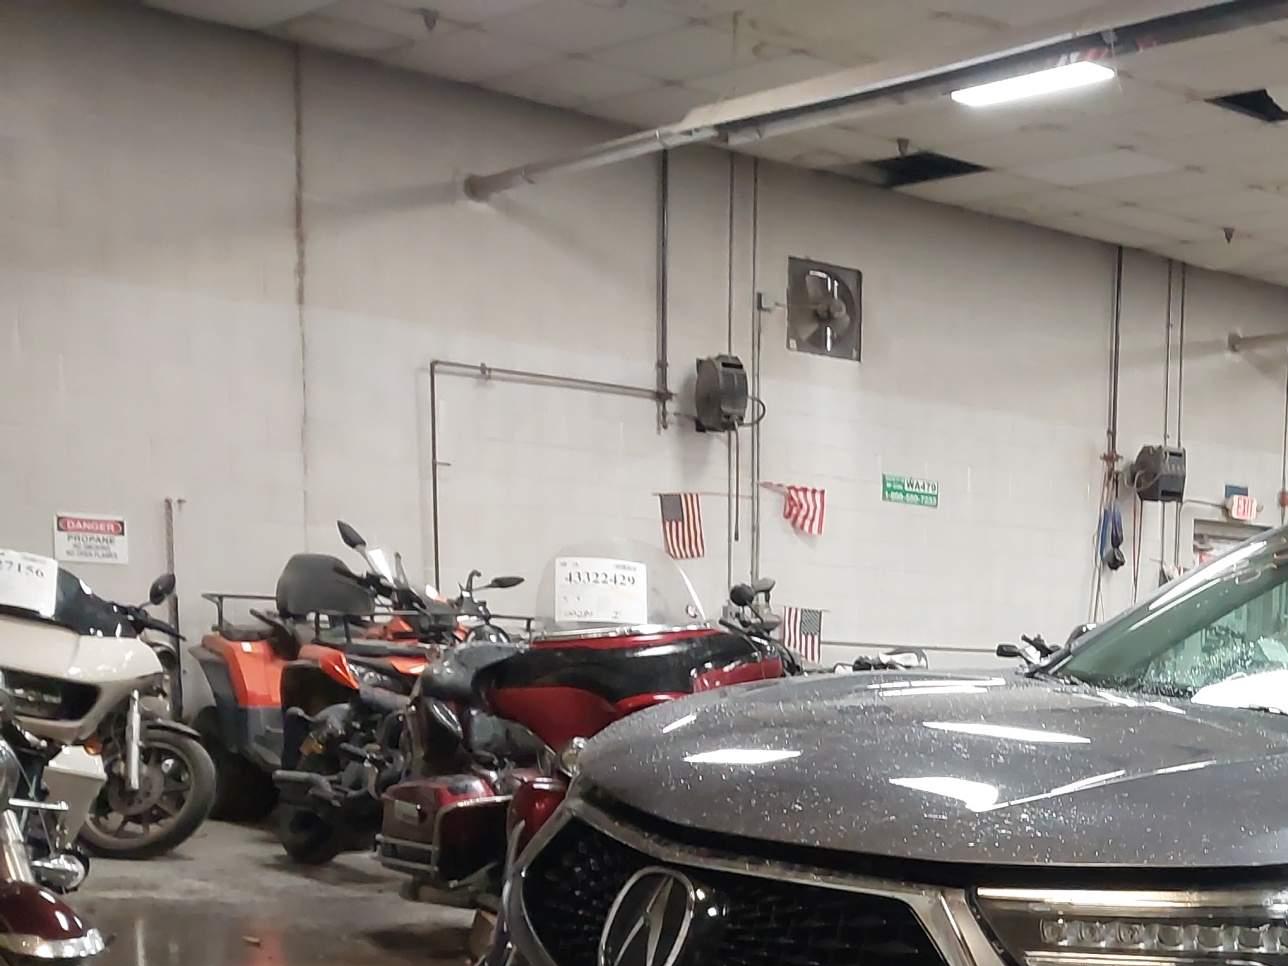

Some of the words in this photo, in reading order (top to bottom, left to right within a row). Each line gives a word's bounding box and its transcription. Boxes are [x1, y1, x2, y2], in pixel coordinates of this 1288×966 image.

[66, 519, 115, 533] DANGER
[67, 534, 116, 544] PROPANE
[564, 571, 636, 586] 43322429
